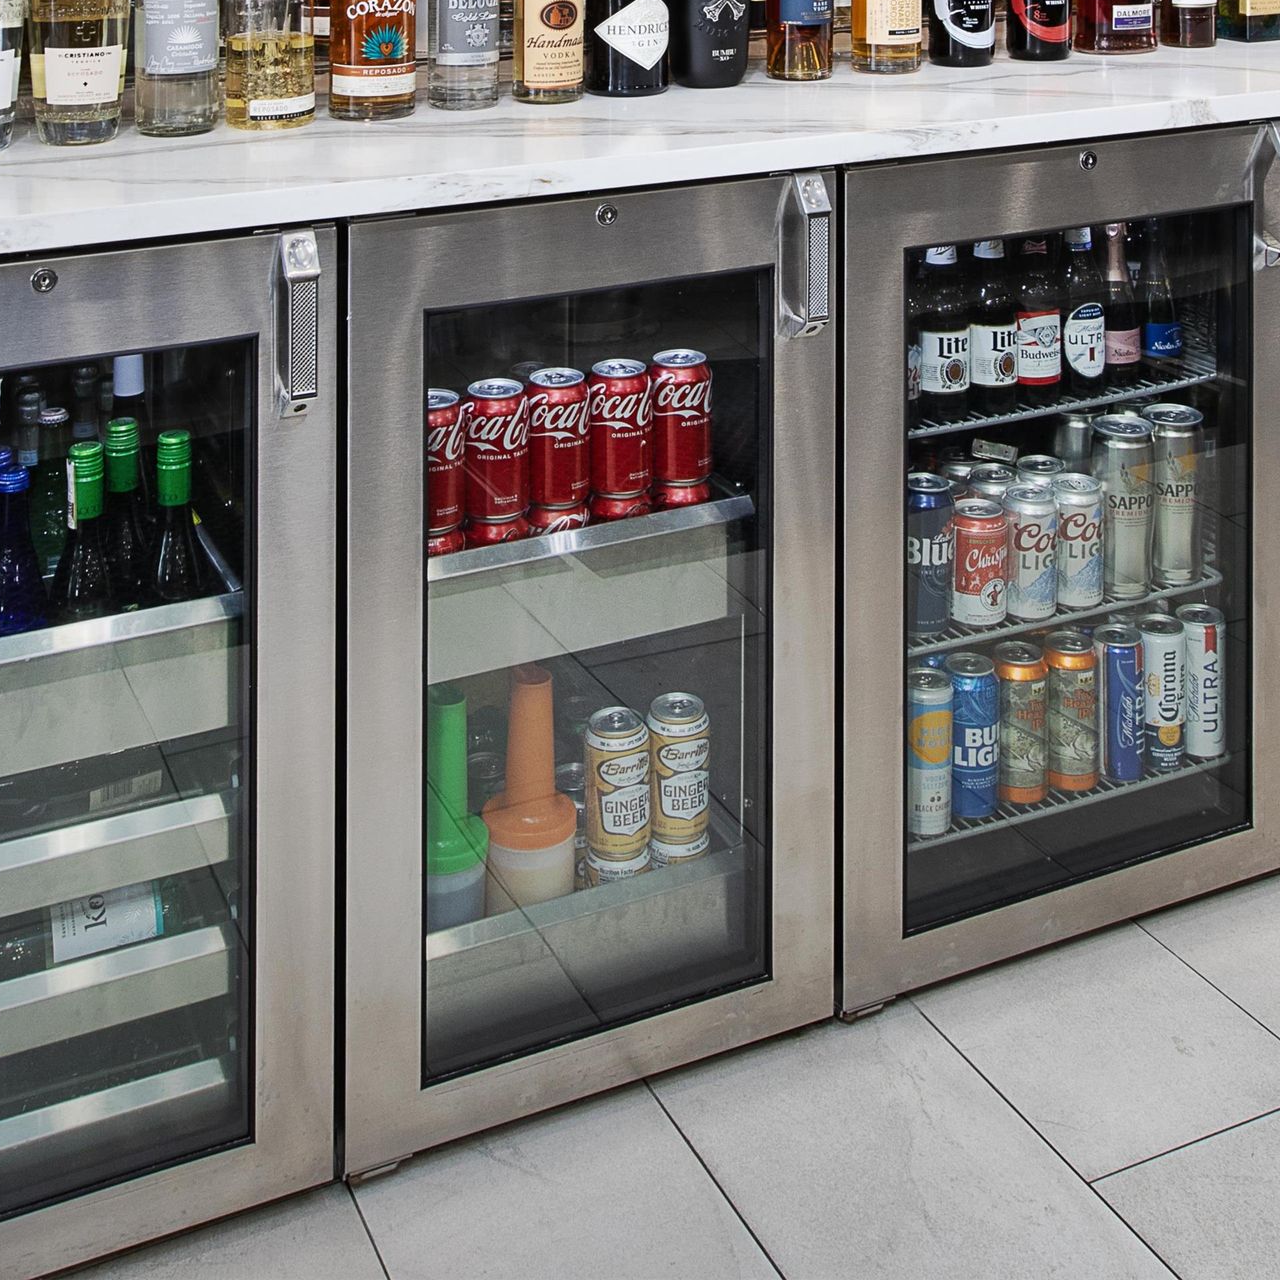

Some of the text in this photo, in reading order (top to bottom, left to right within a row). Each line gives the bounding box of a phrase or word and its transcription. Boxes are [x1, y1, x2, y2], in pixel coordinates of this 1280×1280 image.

[1116, 8, 1151, 18] DALMORE
[638, 39, 658, 48] GIN
[938, 336, 968, 358] Lite
[554, 439, 585, 449] ORIGINAL
[611, 429, 644, 439] ORIGINAL
[1158, 649, 1180, 723] Corona
[1203, 659, 1218, 733] ULTRA
[1187, 670, 1200, 723] Michelob
[1120, 690, 1135, 748] Michelob
[1135, 676, 1145, 755] ULTRA
[671, 793, 705, 811] BEER
[914, 803, 934, 813] BLACK
[613, 807, 646, 827] BEER
